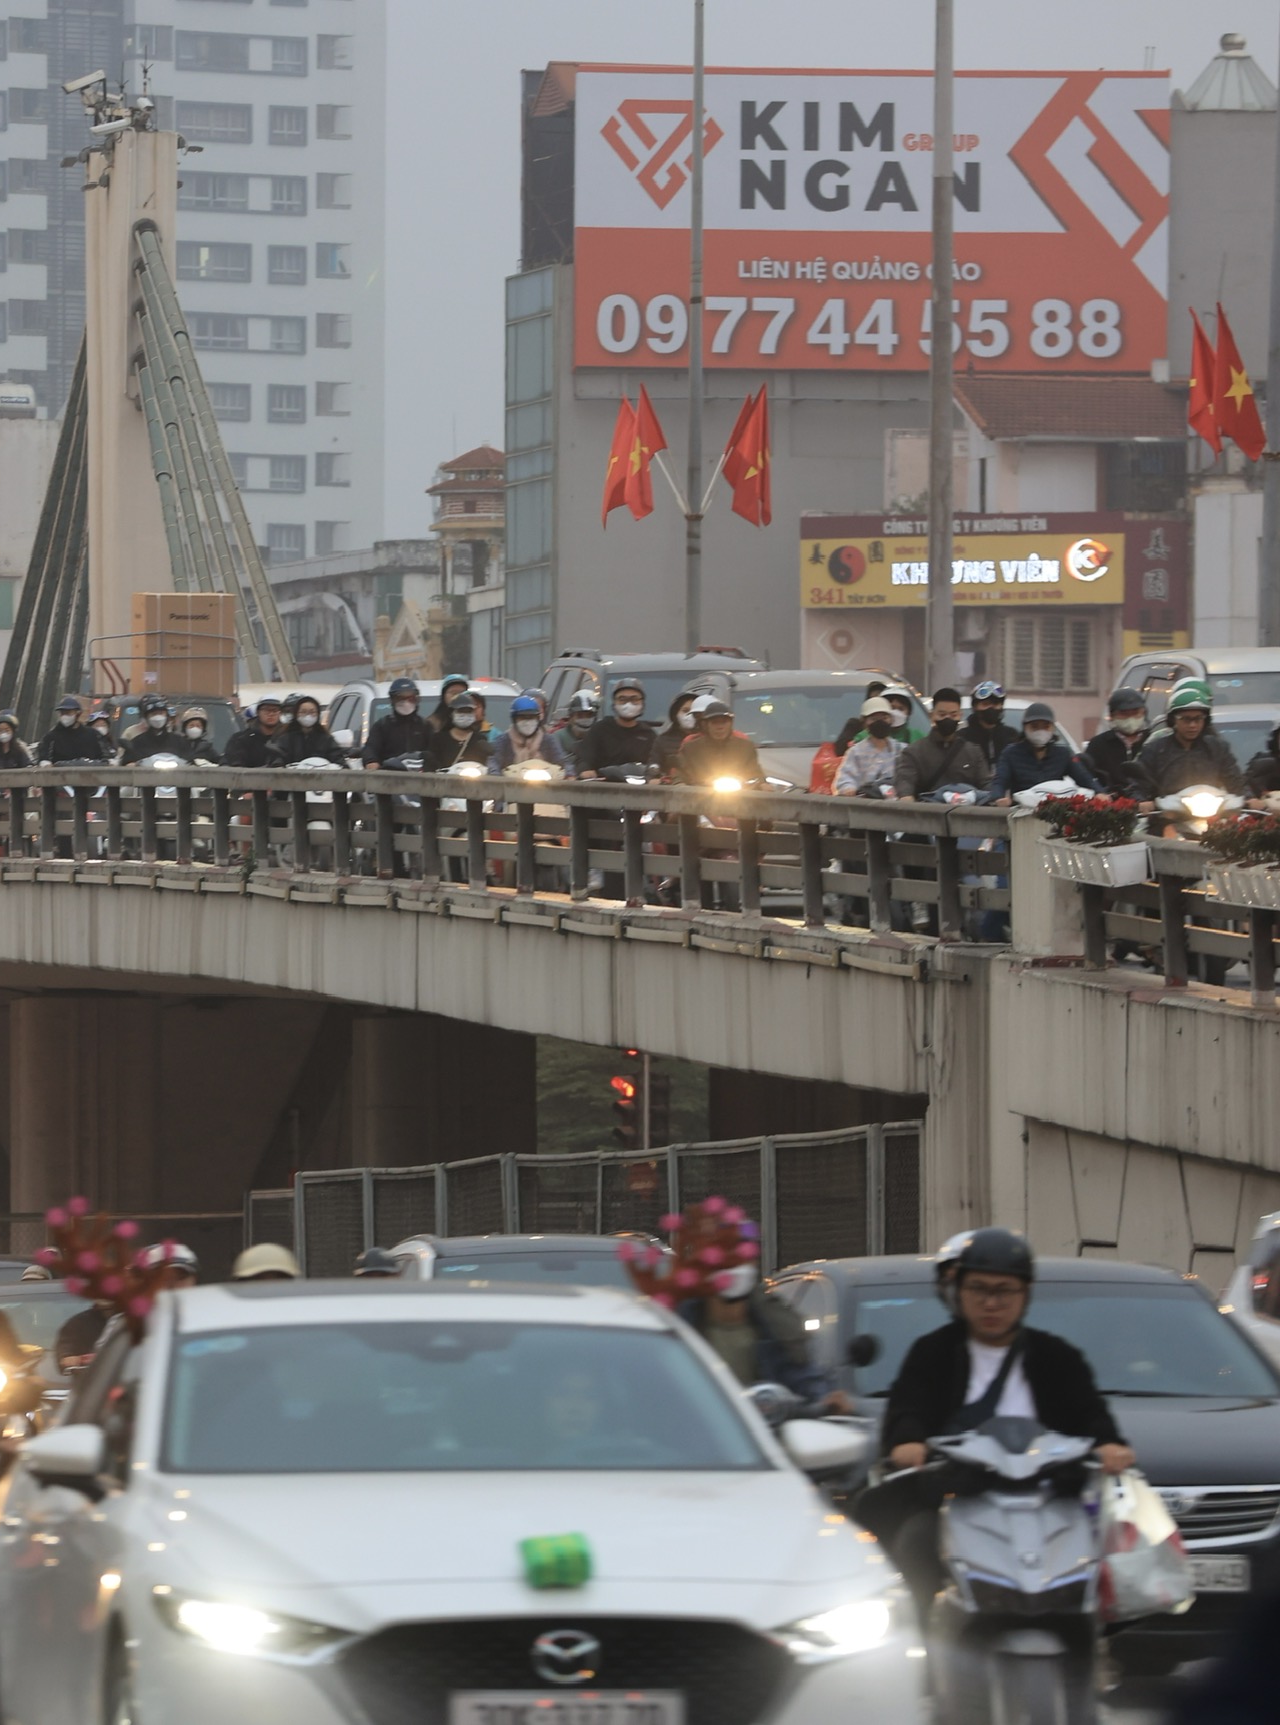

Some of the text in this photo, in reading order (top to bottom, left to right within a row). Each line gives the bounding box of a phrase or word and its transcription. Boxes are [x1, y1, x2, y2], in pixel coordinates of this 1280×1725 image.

[740, 100, 895, 152] KIM
[902, 133, 980, 152] GRUP
[740, 159, 981, 212] NGAN
[738, 256, 790, 280] LIÊN
[795, 256, 827, 284] HỆ
[832, 255, 921, 281] QUẢNG
[596, 293, 689, 355] 09
[705, 296, 796, 355] 77
[807, 298, 899, 357] 44
[1030, 298, 1123, 359] 88
[999, 552, 1061, 584] VIÊN
[810, 587, 846, 604] 341
